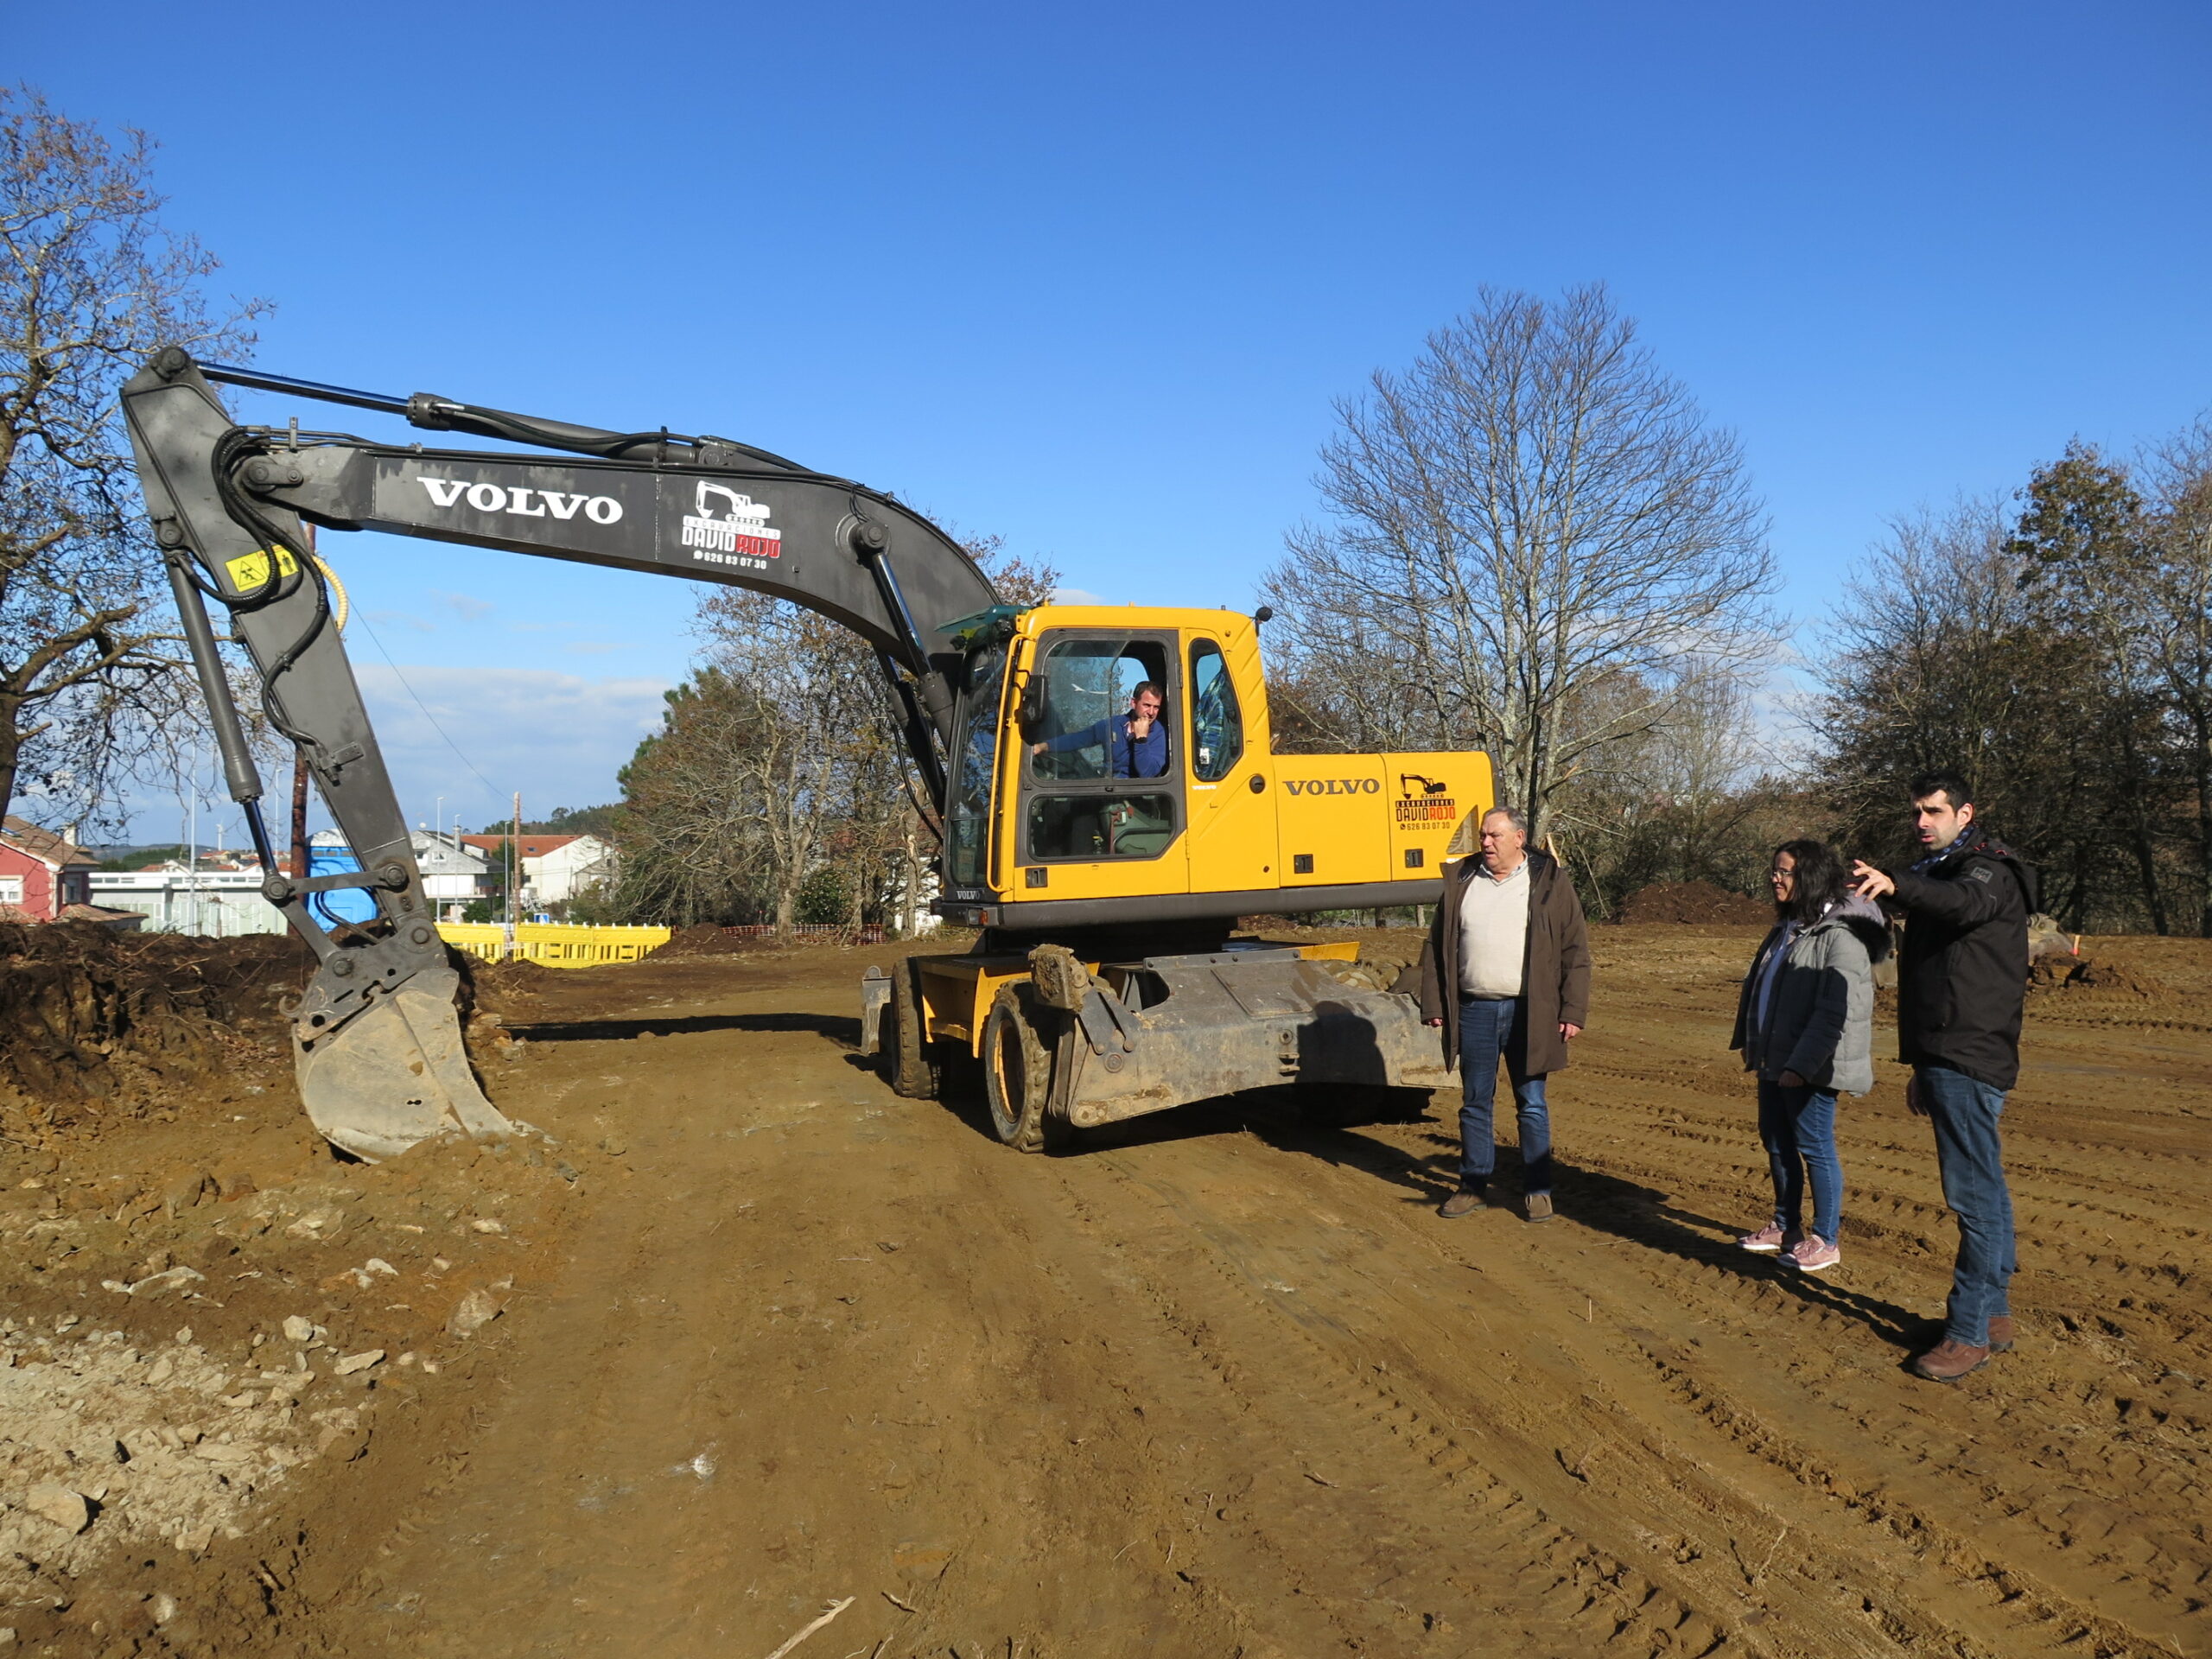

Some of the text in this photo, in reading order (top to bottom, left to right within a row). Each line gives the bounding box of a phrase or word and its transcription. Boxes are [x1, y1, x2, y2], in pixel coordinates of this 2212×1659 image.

[416, 476, 623, 524] VOLVO
[685, 517, 779, 539] EXCAVACIONES
[703, 551, 767, 569] 626 83 07 30
[1281, 778, 1380, 796] VOLVO
[1441, 821, 1451, 830] 30
[956, 890, 981, 899] VOLVO
